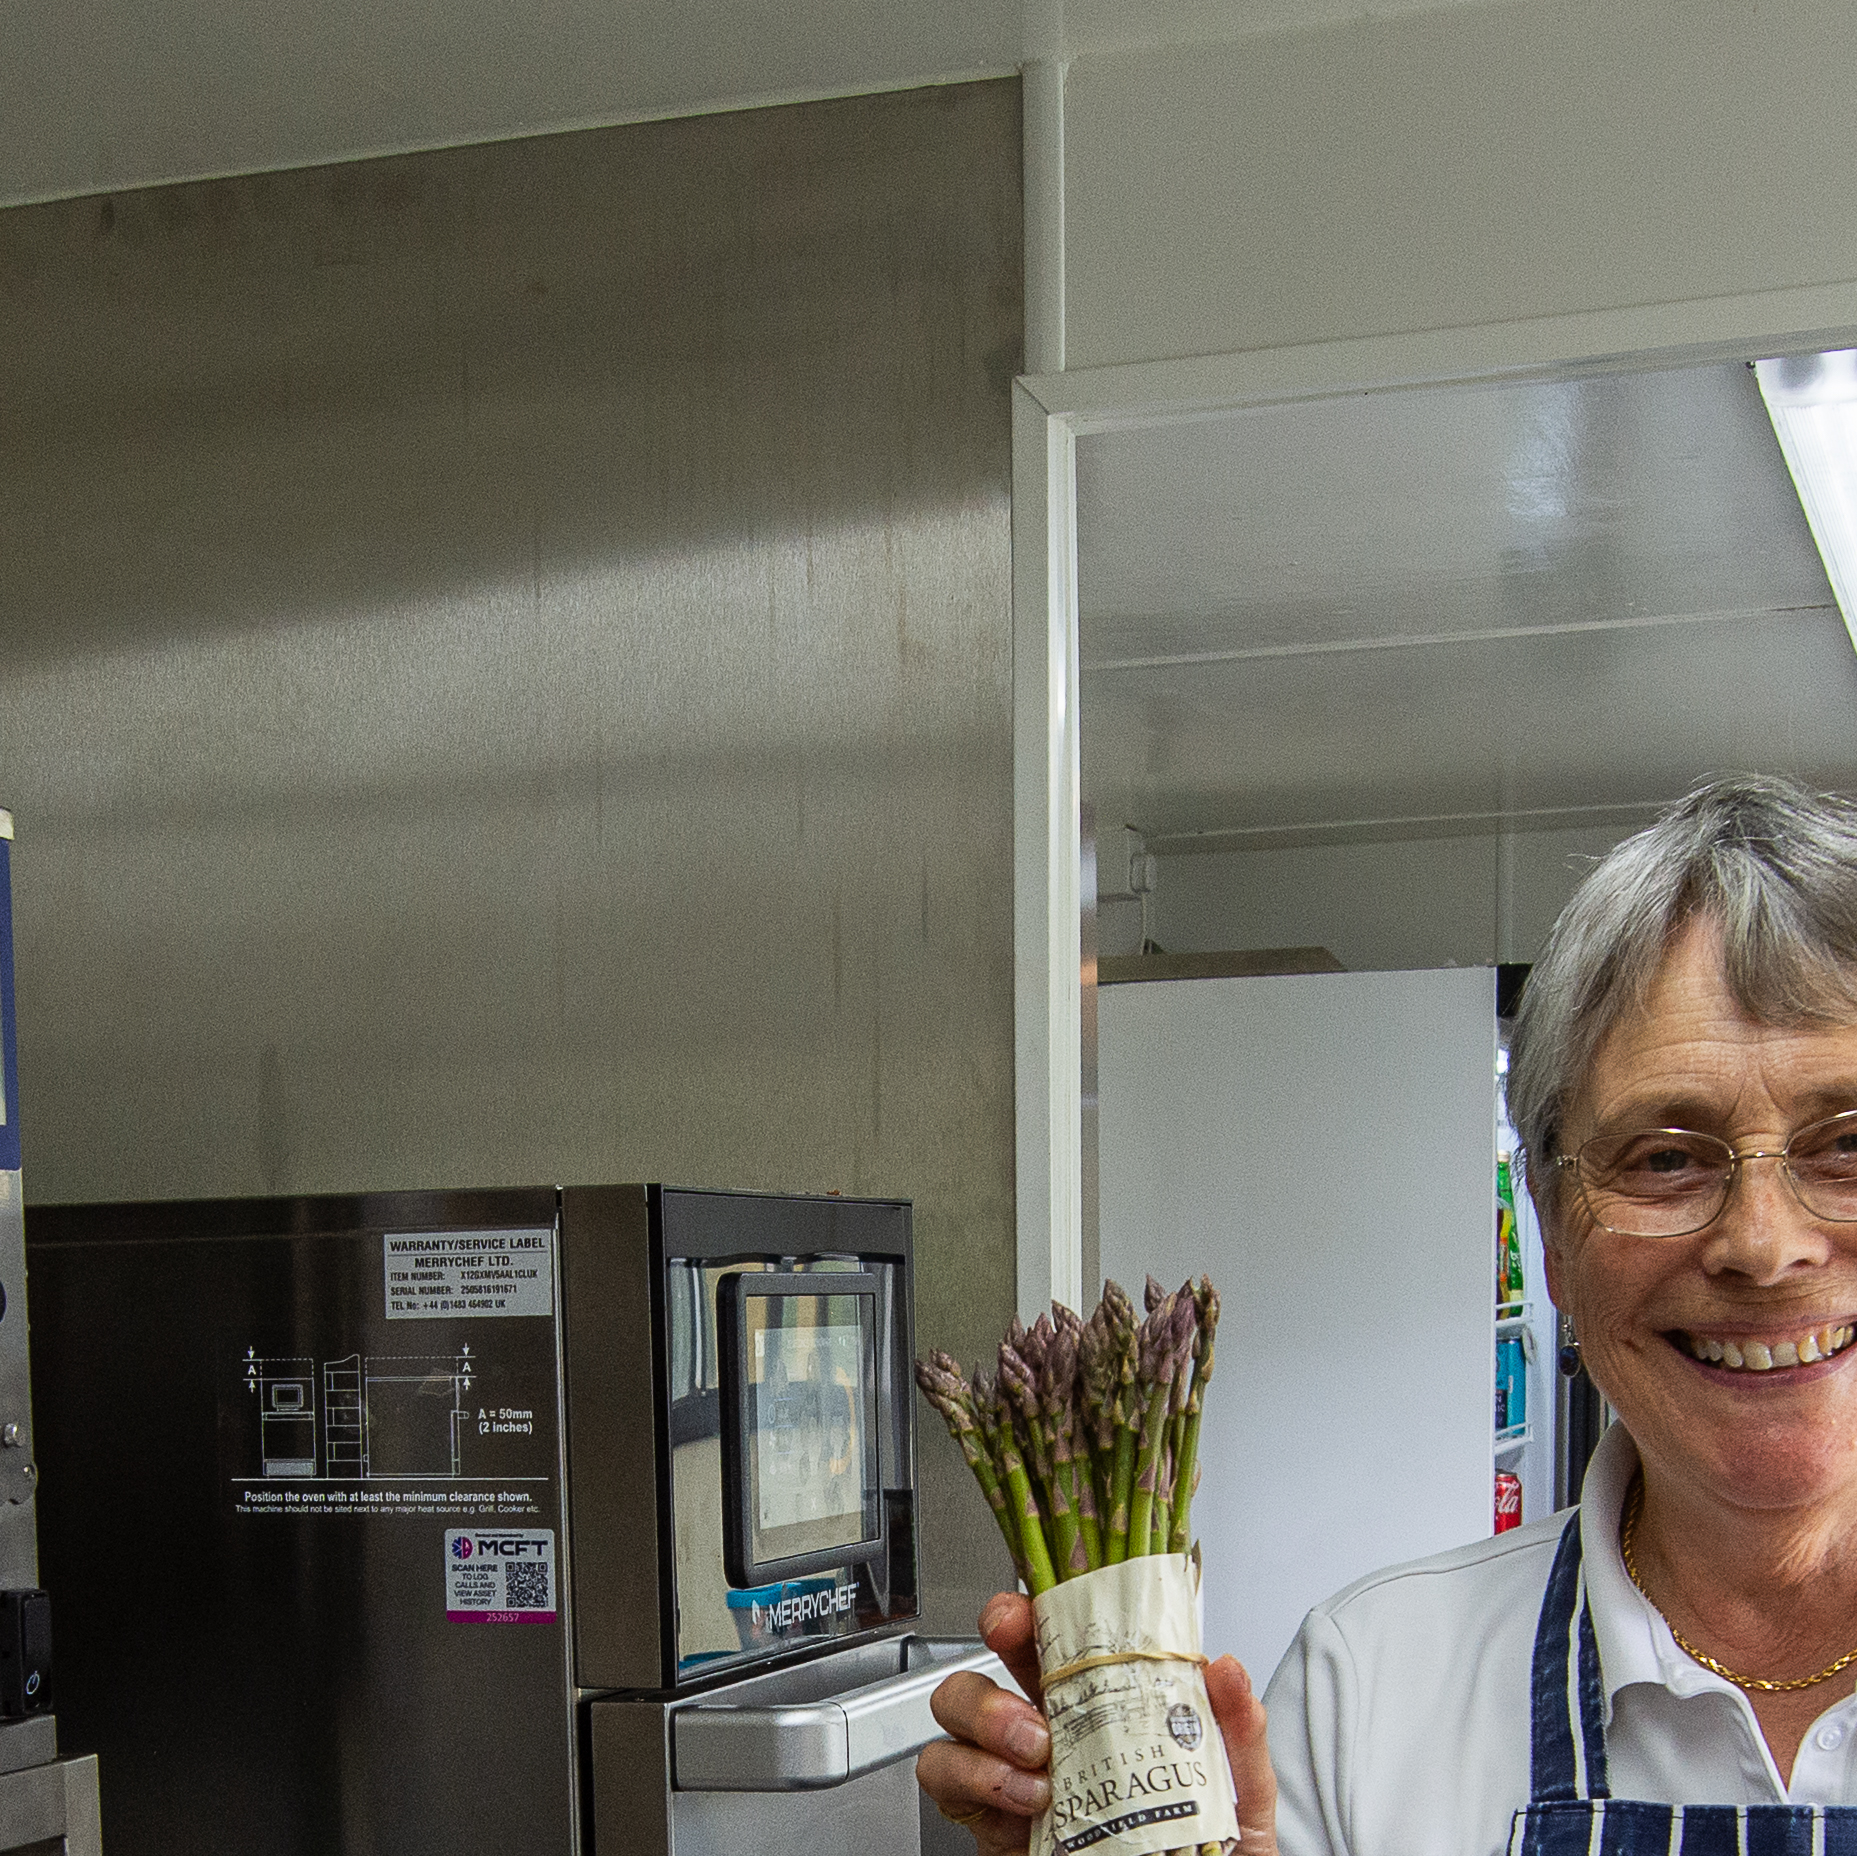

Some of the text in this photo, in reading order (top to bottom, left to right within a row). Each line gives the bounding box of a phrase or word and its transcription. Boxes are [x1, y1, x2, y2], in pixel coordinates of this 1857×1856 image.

[390, 1237, 545, 1252] WARRANTY/SERVICE LABEL
[414, 1255, 514, 1268] MERRYCHEF LTD.
[390, 1271, 445, 1281] ITEM NUMBER:
[390, 1285, 453, 1296] SERIAL NUMBER:
[390, 1302, 403, 1310] TEL
[495, 1299, 506, 1309] UK
[248, 1365, 257, 1375] A
[463, 1362, 471, 1372] A
[478, 1409, 487, 1419] A
[499, 1409, 532, 1419] 50mm
[492, 1422, 533, 1433] inches)
[244, 1491, 533, 1502] Position the oven with at least the minimum clearance shown.
[285, 1505, 308, 1513] should
[310, 1505, 322, 1513] not
[324, 1505, 333, 1513] be
[478, 1540, 548, 1556] MCFT
[452, 1564, 498, 1572] SCAN HERE
[460, 1598, 492, 1606] HISTORY
[769, 1582, 857, 1630] MERRYCHEF
[487, 1612, 519, 1622] 252657
[1063, 1744, 1165, 1791] BRITISH
[1053, 1761, 1207, 1828] SPARAGUS
[1066, 1803, 1194, 1849] WOODIELD FARM
